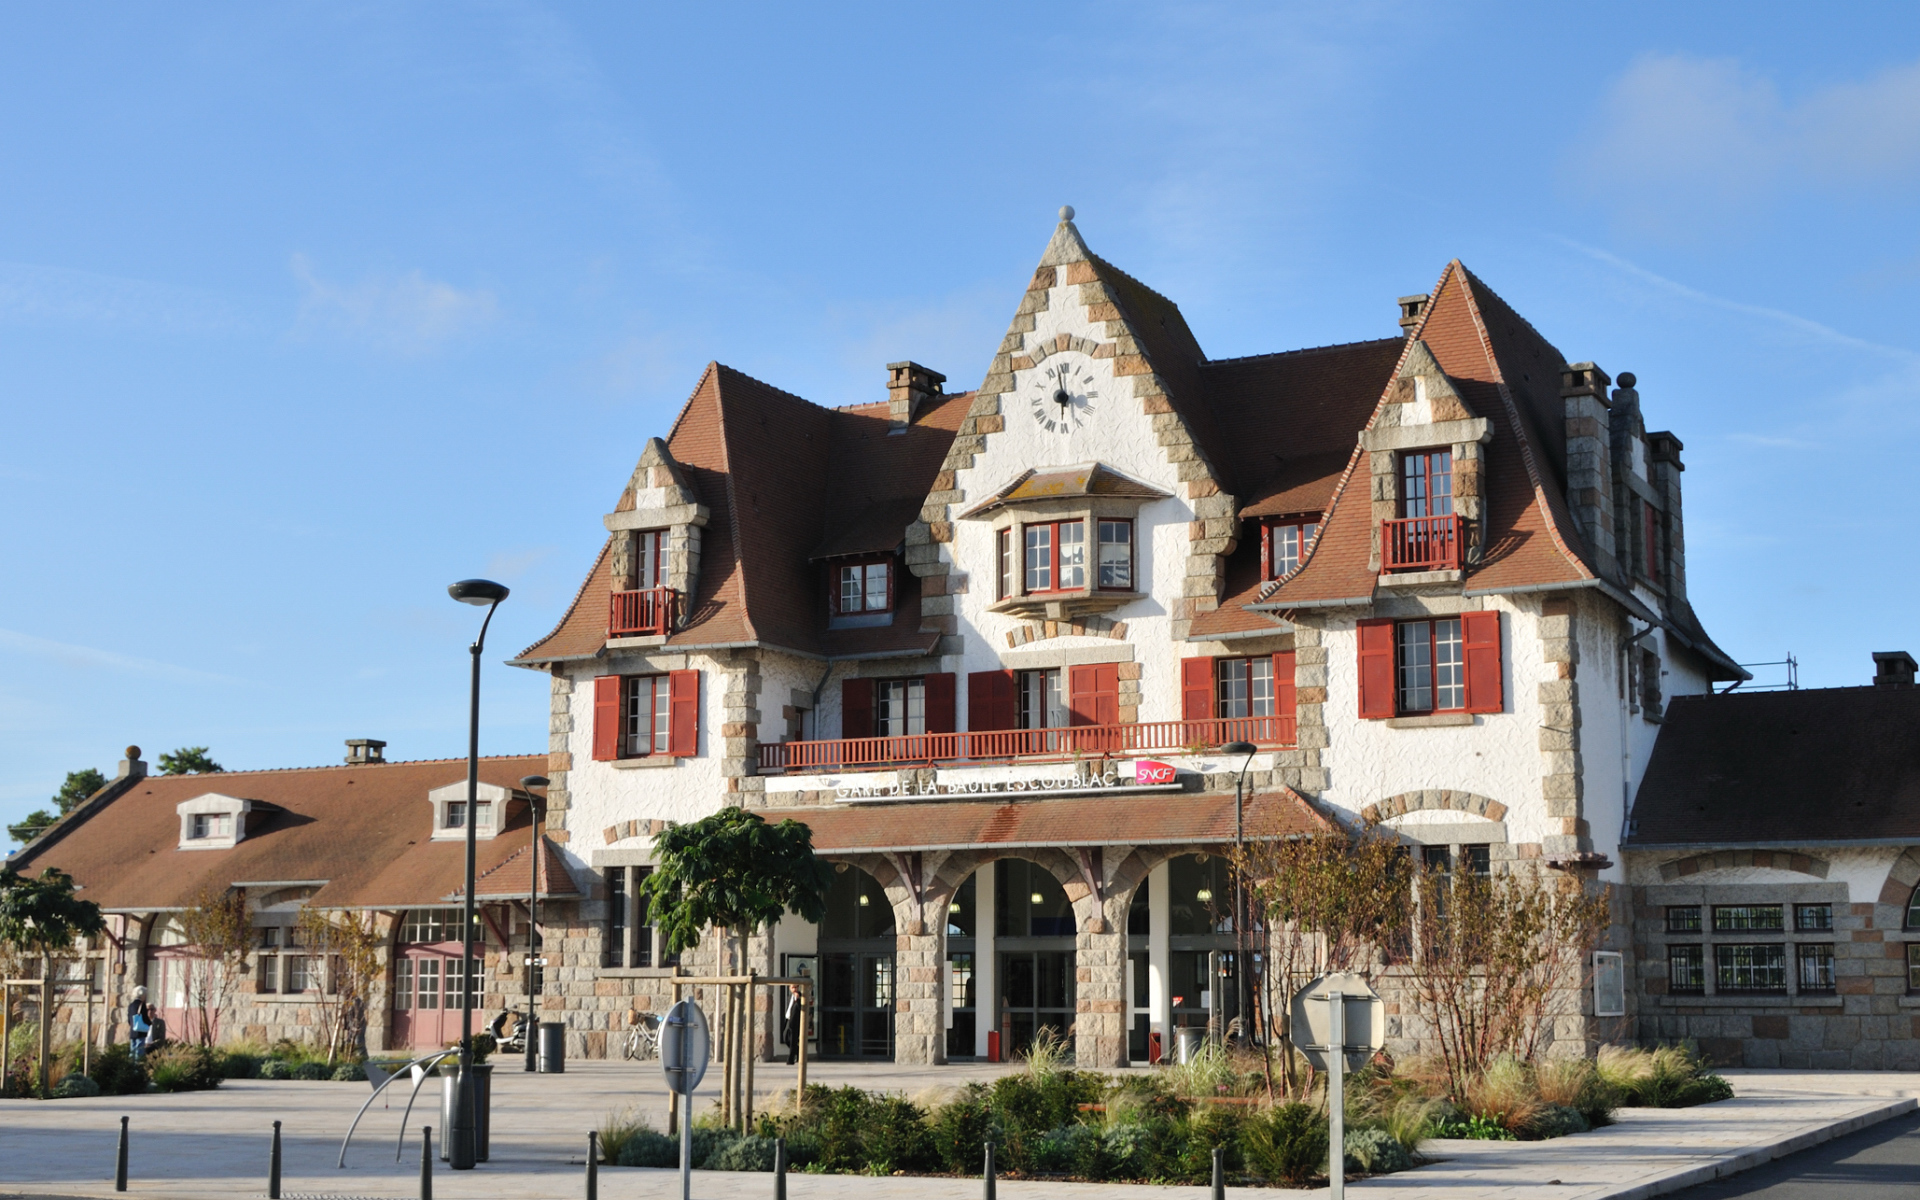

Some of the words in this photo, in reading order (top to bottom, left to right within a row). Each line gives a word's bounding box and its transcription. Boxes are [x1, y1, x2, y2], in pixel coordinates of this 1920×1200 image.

[1035, 382, 1046, 391] X
[1138, 768, 1173, 781] SNCF
[836, 783, 881, 798] GARE
[889, 780, 910, 796] DE
[919, 779, 938, 795] LA
[948, 777, 998, 794] BAULE
[1006, 771, 1115, 792] ESCOUBLAC
